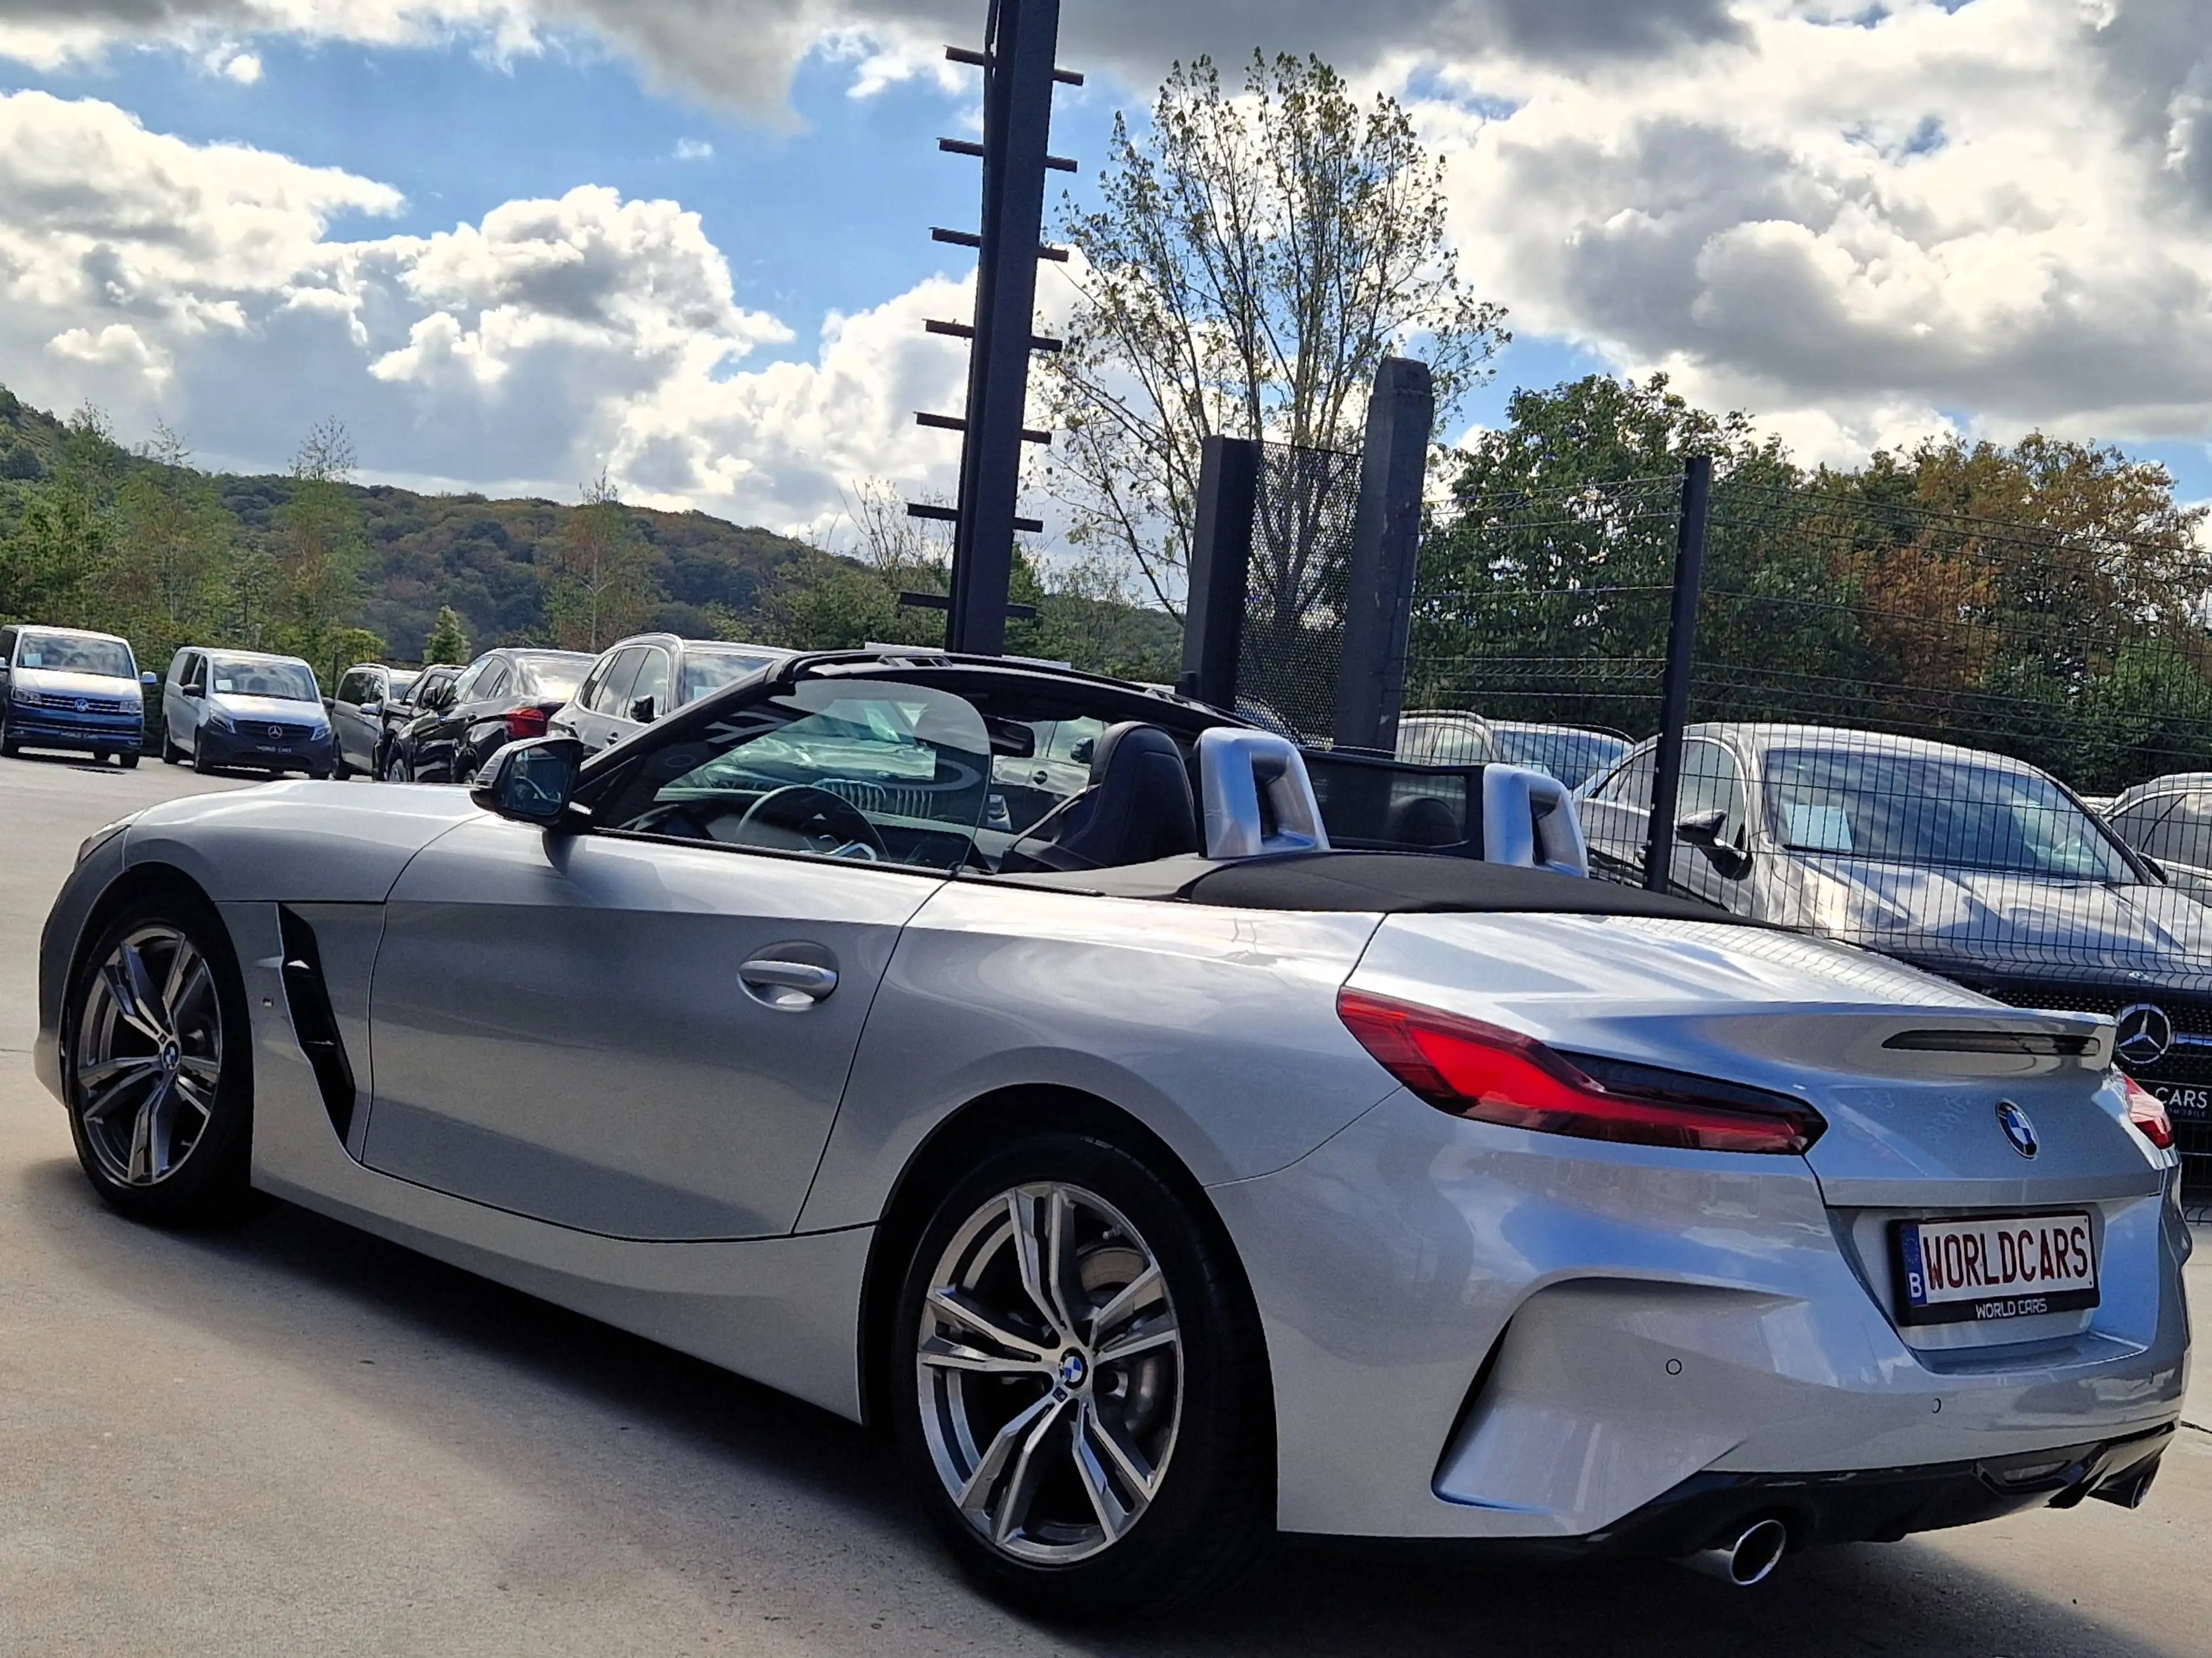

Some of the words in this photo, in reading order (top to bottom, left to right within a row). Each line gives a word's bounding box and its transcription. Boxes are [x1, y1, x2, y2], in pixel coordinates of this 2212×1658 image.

[2155, 1087, 2207, 1109] CARS
[1923, 1226, 2088, 1290] WORLDCARS
[1909, 1273, 1922, 1297] B
[1975, 1301, 2016, 1319] WORLD
[2018, 1298, 2048, 1315] CARS
